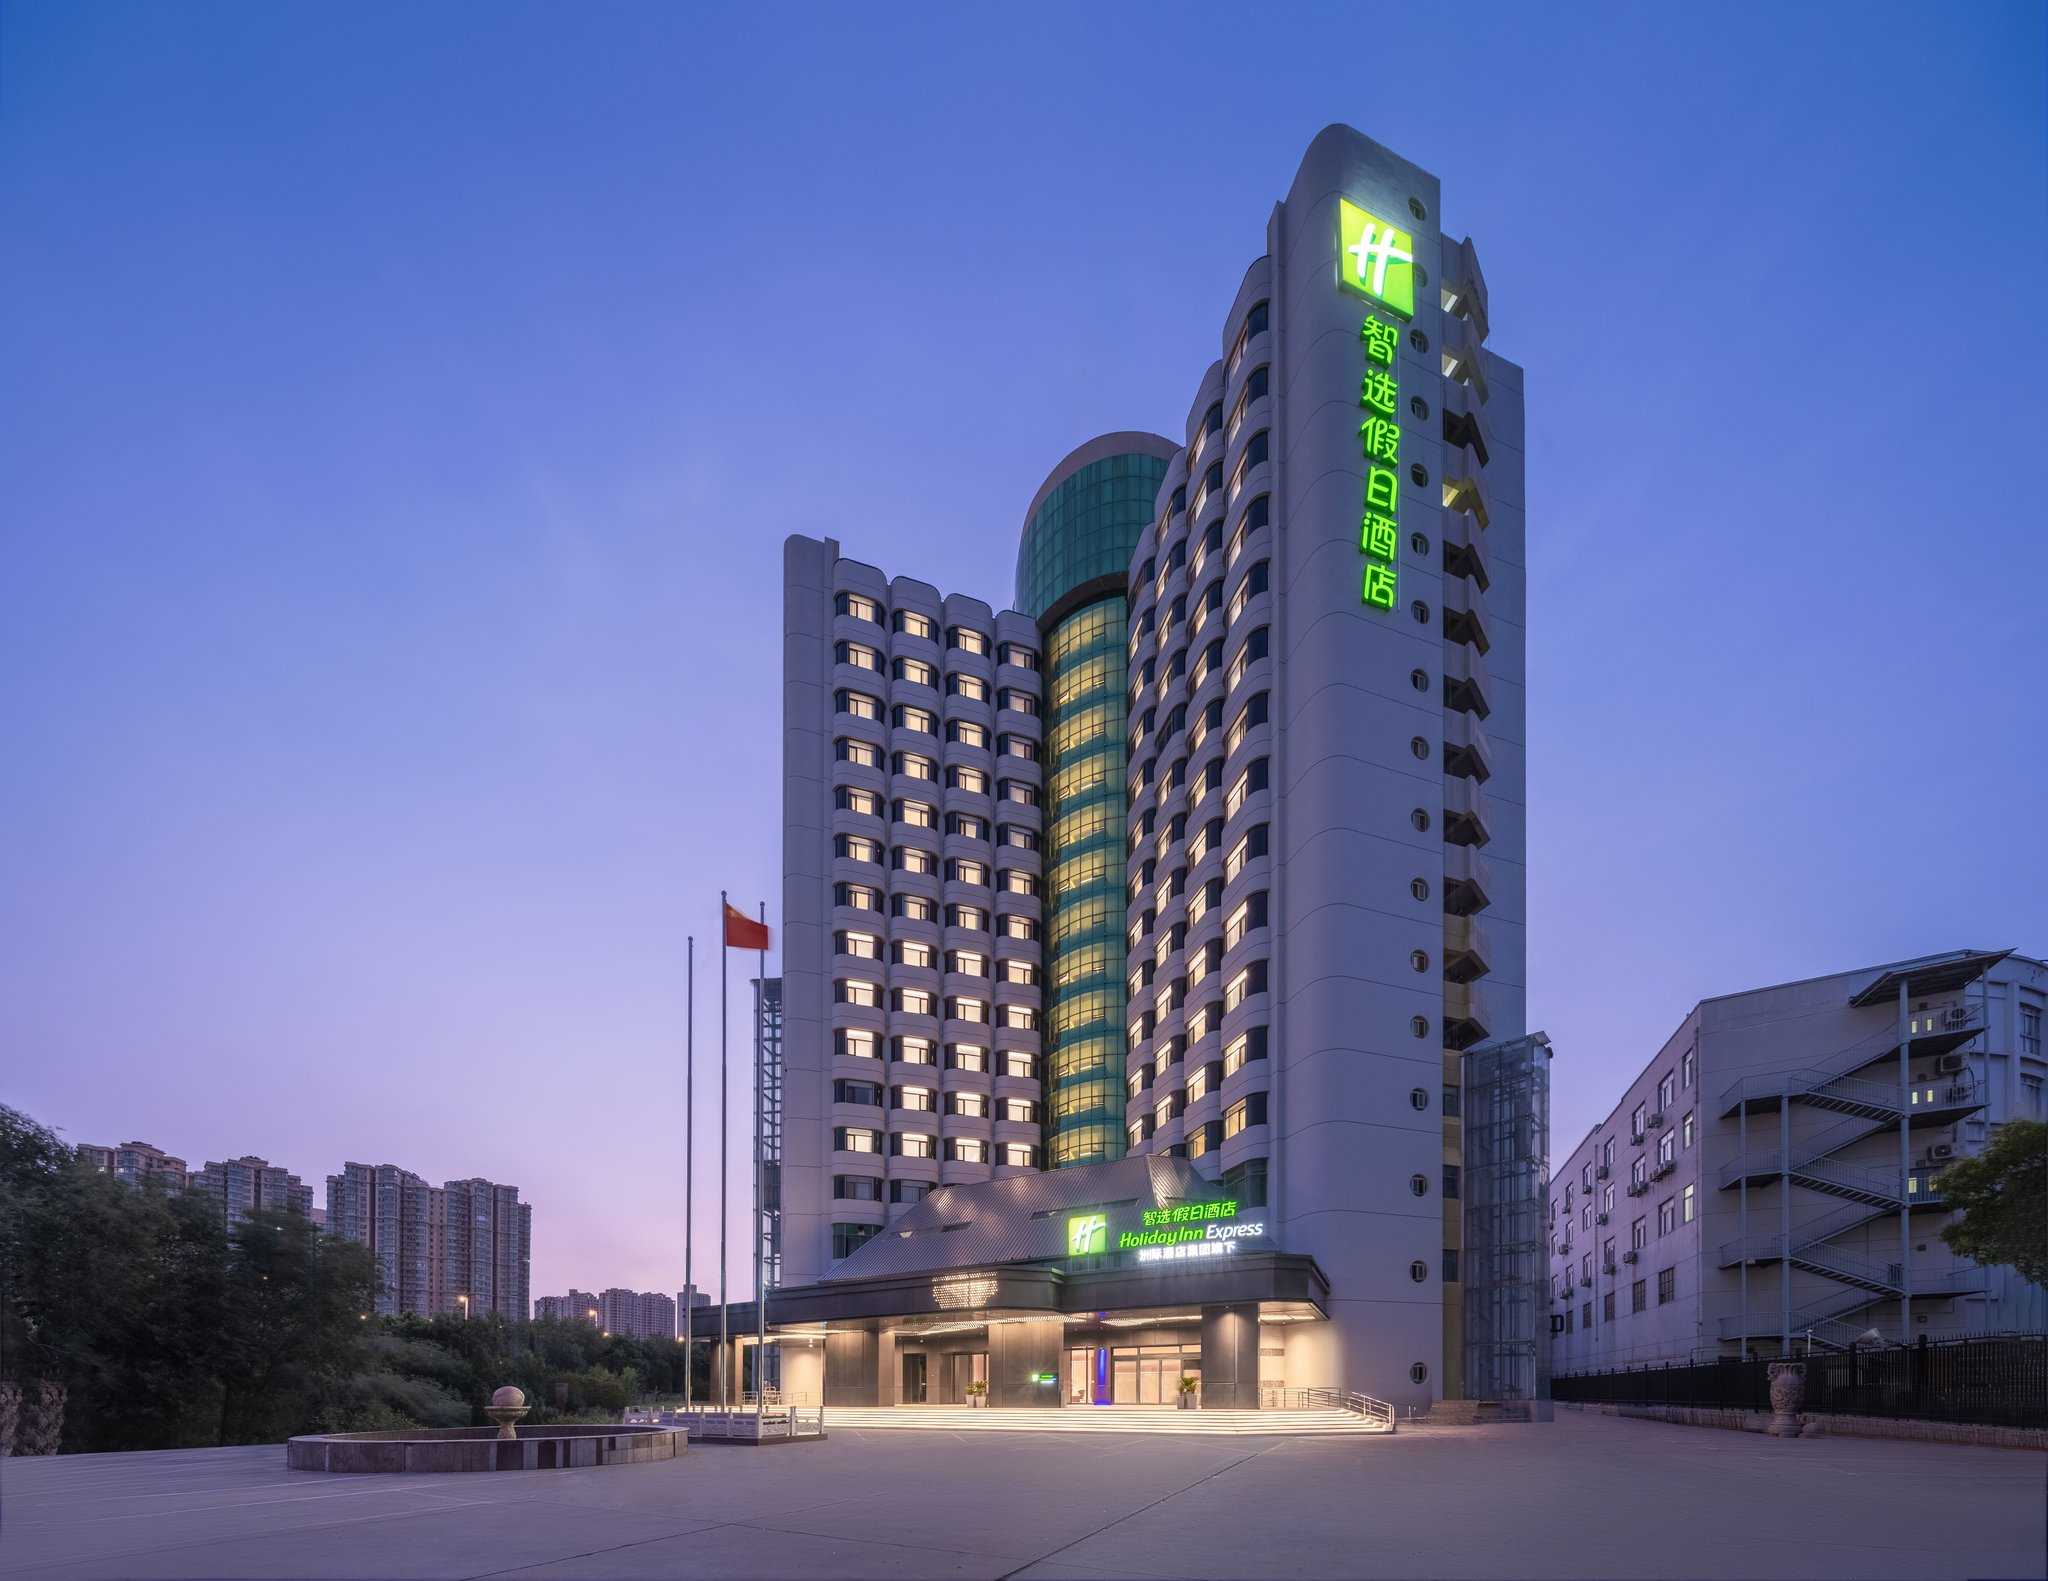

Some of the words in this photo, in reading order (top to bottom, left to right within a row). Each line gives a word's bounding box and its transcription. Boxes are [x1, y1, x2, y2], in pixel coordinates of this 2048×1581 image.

[1361, 314, 1400, 609] 智选假日酒店
[1143, 1201, 1237, 1226] 智选假日酒店
[1119, 1229, 1178, 1248] Holiday
[1179, 1226, 1204, 1241] Inn
[1206, 1223, 1264, 1241] Express
